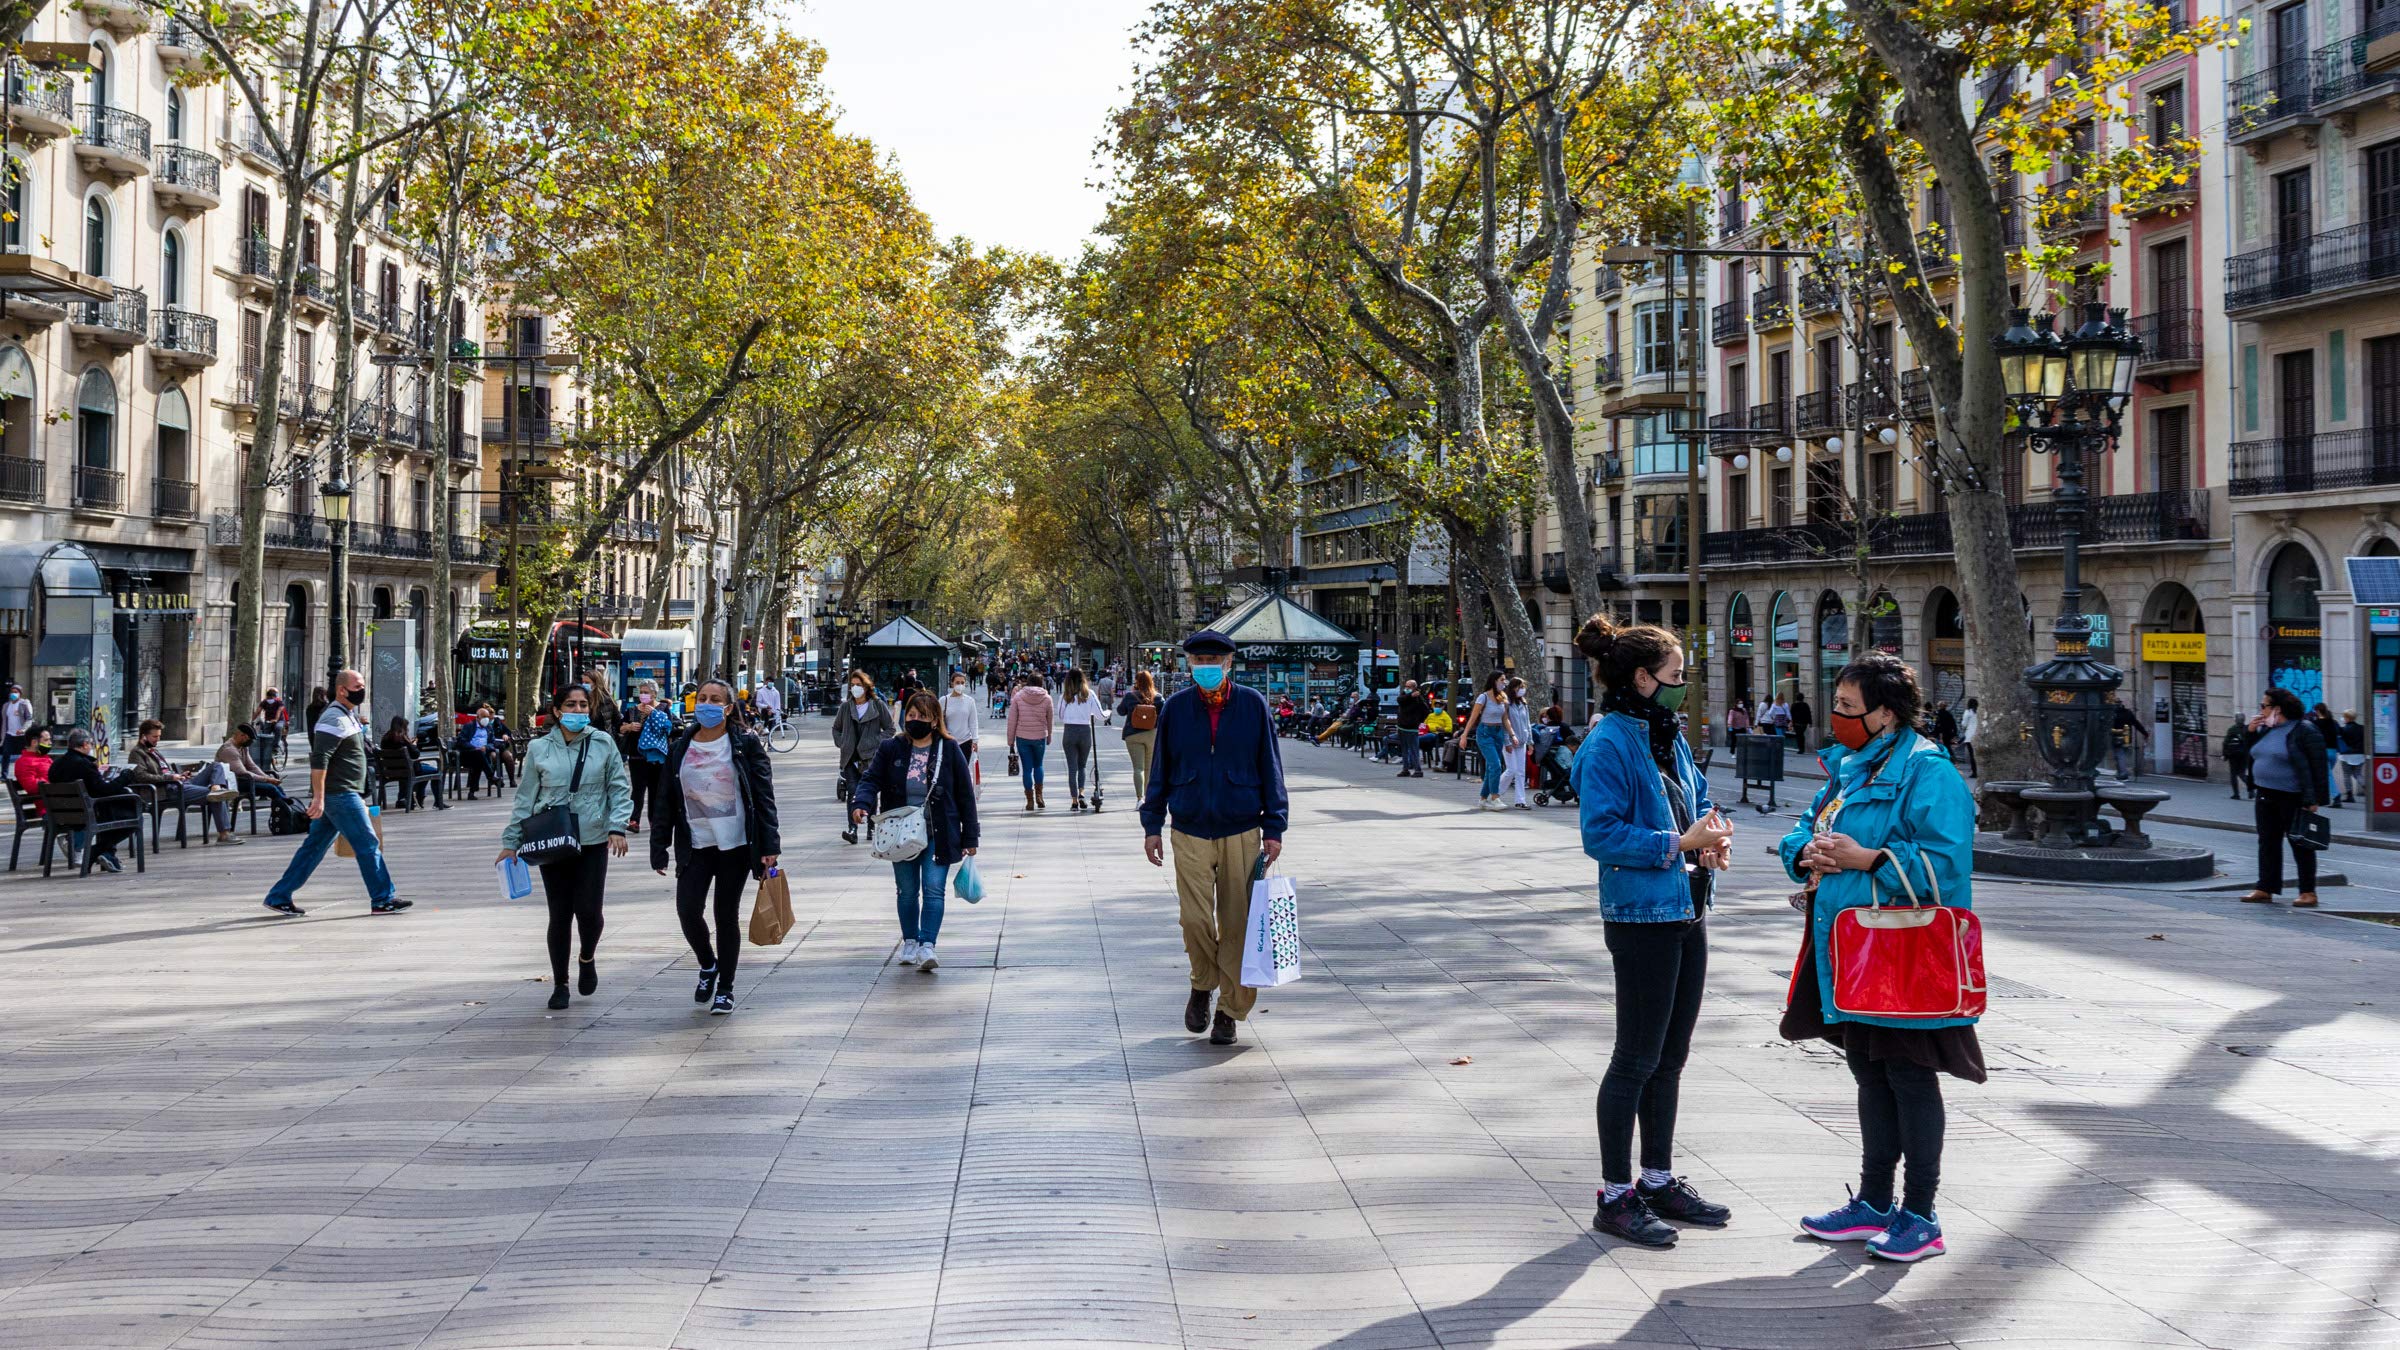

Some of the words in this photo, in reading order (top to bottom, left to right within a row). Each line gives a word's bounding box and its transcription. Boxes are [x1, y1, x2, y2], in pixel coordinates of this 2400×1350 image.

[520, 841, 537, 854] THIS
[538, 840, 546, 850] IS
[547, 835, 566, 849] NOW
